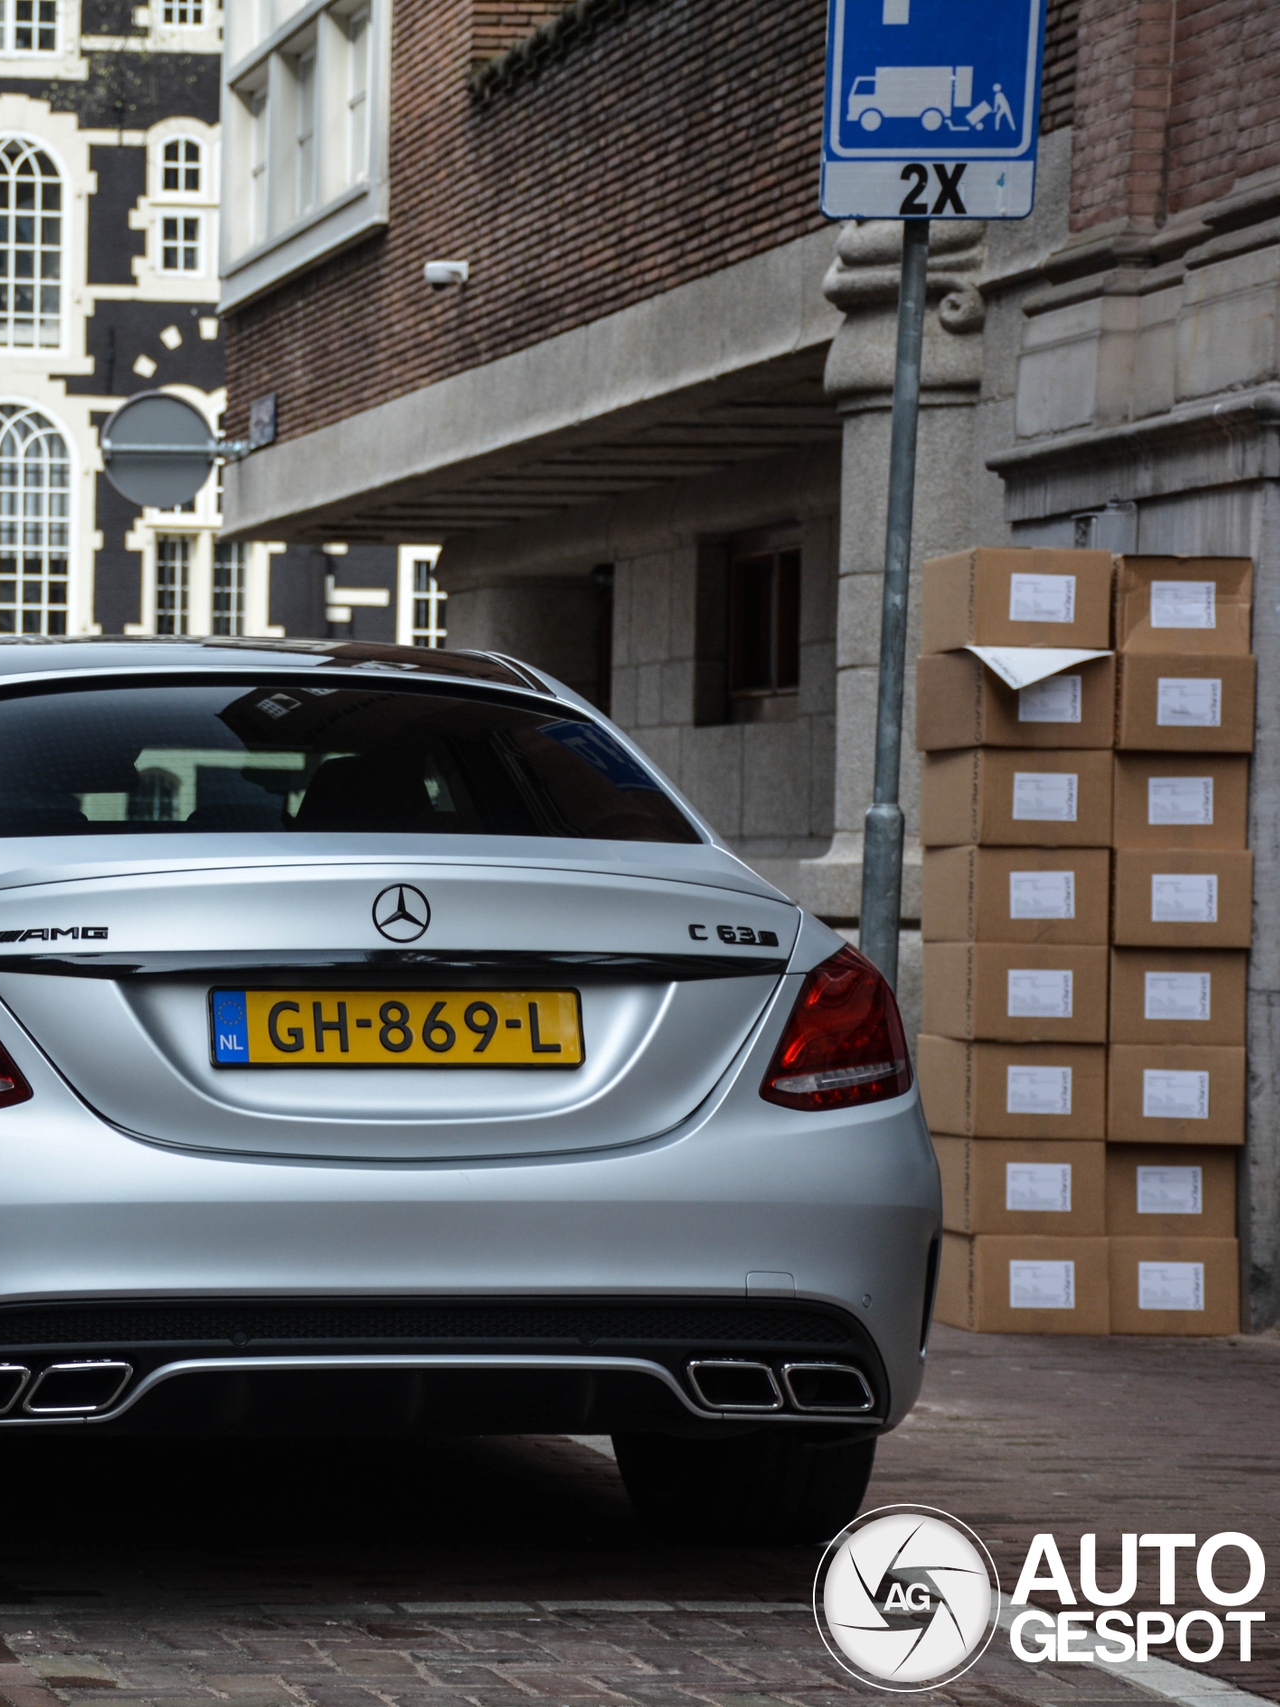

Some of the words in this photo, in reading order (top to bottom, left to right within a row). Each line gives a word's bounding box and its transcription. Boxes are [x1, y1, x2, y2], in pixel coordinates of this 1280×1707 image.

[899, 162, 967, 216] 2X
[18, 926, 109, 942] AMG
[688, 923, 709, 941] C
[267, 1000, 563, 1054] GH-869-L
[219, 1034, 244, 1051] NL
